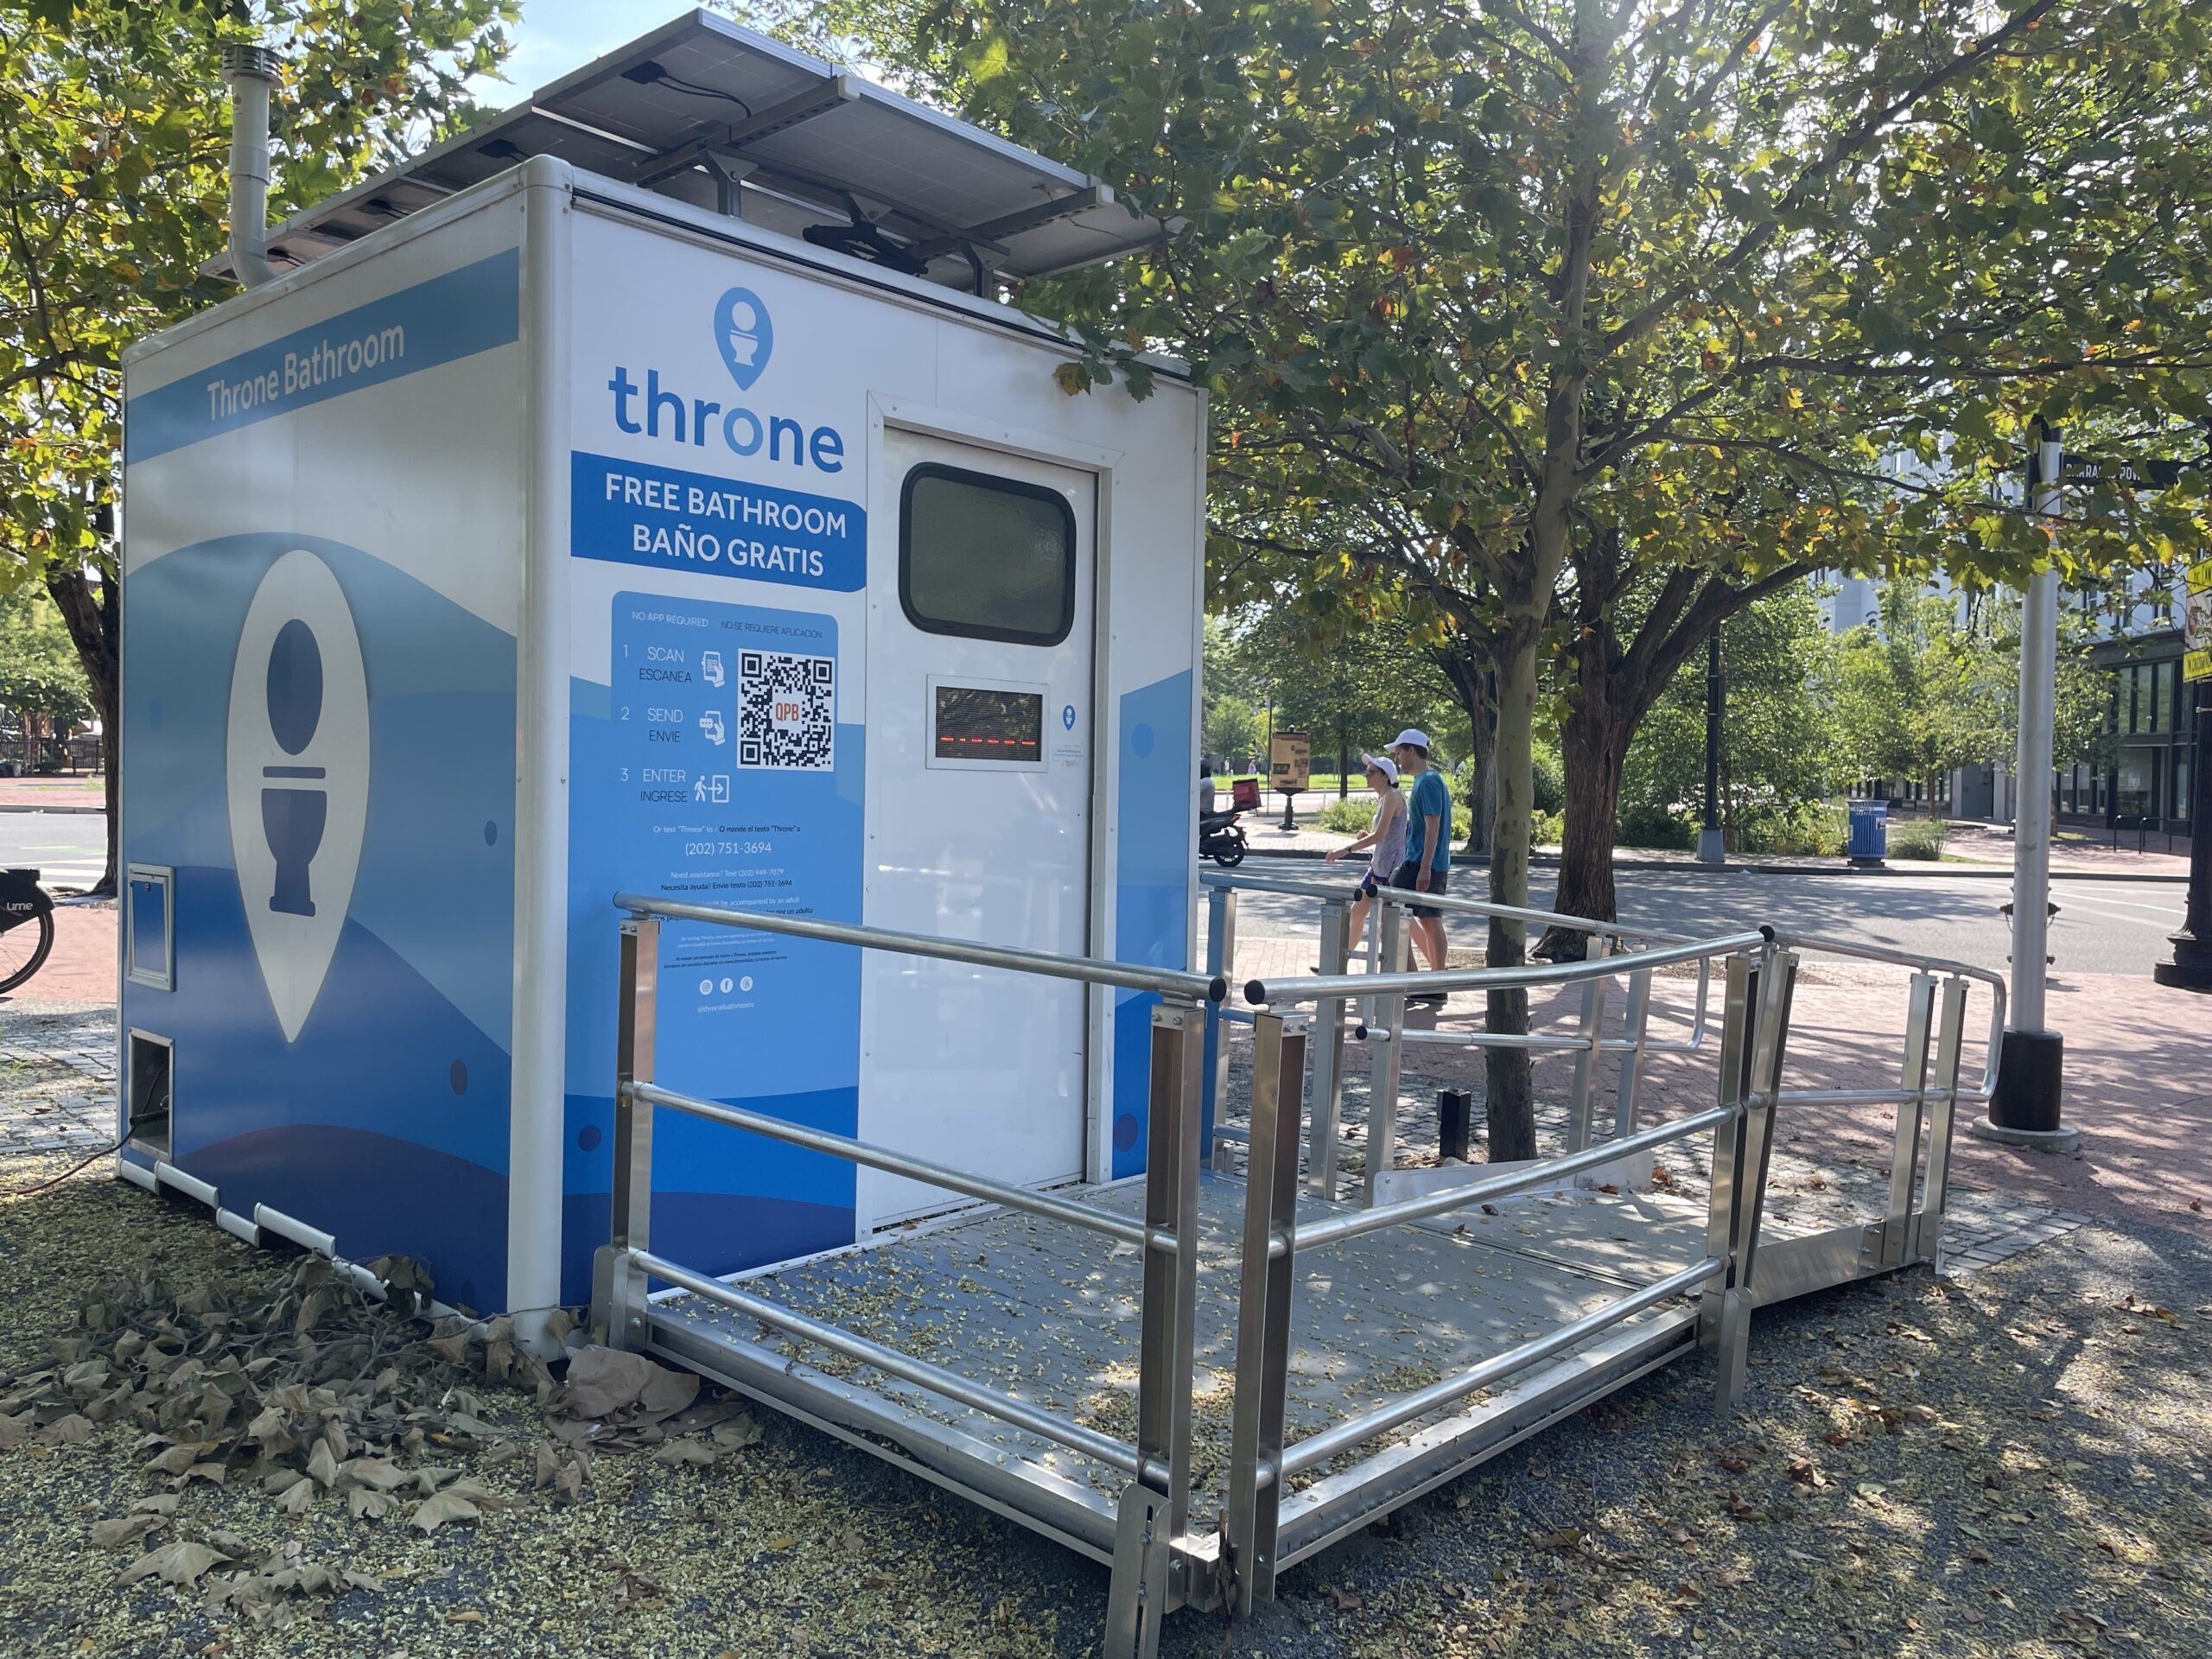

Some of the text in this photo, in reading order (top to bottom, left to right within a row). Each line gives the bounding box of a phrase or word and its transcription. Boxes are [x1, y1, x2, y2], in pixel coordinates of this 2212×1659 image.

[207, 325, 405, 422] Throne Bathroom
[608, 365, 845, 474] throne
[606, 473, 847, 538] FREE BATHROOM
[633, 524, 824, 577] BAÑO GRATIS
[632, 611, 709, 628] NO APP REQUIRED
[721, 620, 734, 630] NO
[734, 621, 743, 631] SE
[745, 622, 779, 635] REQUIERE
[623, 644, 684, 664] 1 SCAN
[639, 668, 692, 683] ESCANEA
[620, 707, 683, 723] 2 SEND
[775, 702, 800, 721] QPB
[649, 730, 681, 743] ENVIE
[620, 768, 686, 783] 3 ENTER
[640, 790, 688, 803] INGRESE
[652, 825, 662, 834] Or
[684, 842, 772, 856] (202) 751-3694
[690, 870, 724, 879] assistance?
[724, 869, 738, 878] Text
[661, 883, 689, 892] Necesita
[689, 882, 711, 892] ayuda?
[712, 881, 730, 890] Envie
[763, 880, 792, 888] 751-3694
[729, 898, 768, 906] accompanied
